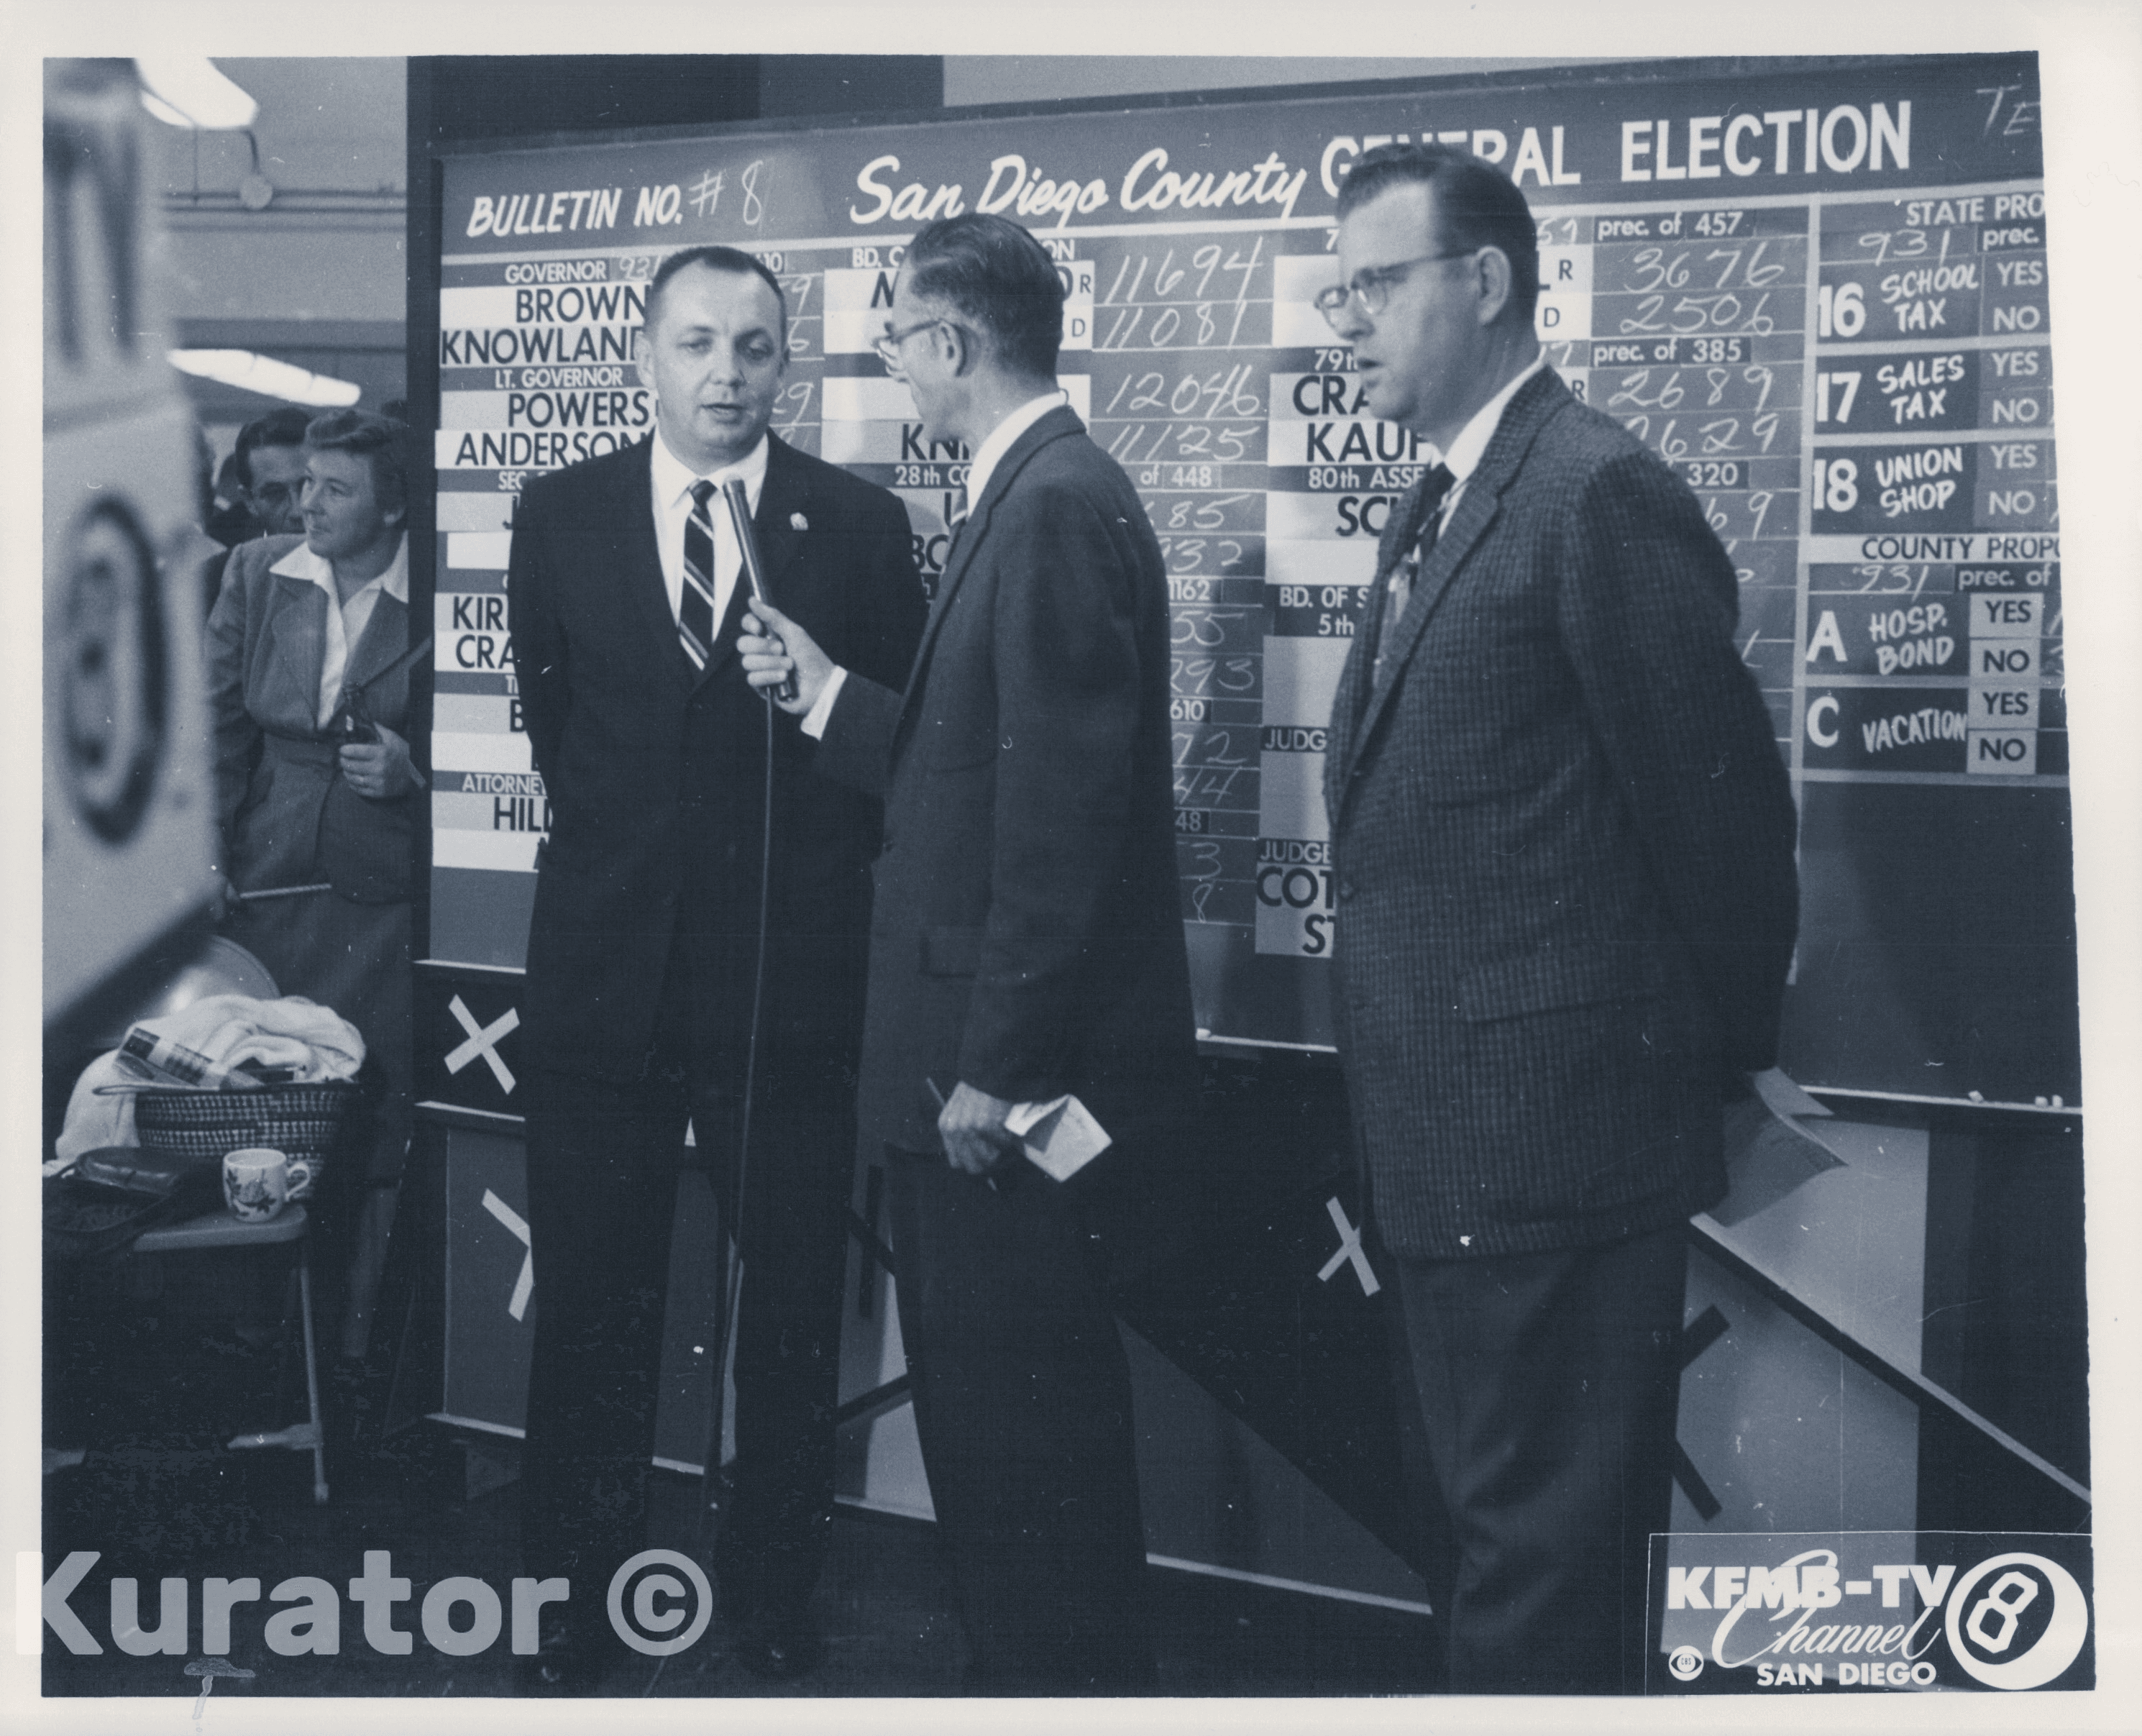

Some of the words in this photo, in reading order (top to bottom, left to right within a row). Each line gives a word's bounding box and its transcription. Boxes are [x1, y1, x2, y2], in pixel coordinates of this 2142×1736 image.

[851, 155, 965, 224] San
[976, 154, 1109, 229] Diego
[1120, 147, 1307, 223] County
[1320, 124, 1581, 198] GRAL
[1621, 100, 1911, 183] ELECTION
[741, 160, 764, 226] 8
[466, 187, 623, 237] BULLETIN
[633, 184, 683, 227] NO.
[1905, 197, 1985, 227] STATE
[1598, 219, 1649, 242] prec.
[1659, 211, 1683, 236] of
[1695, 211, 1744, 236] 457
[1982, 226, 2039, 252] prec.
[505, 260, 606, 284] GOVERNOR
[853, 247, 883, 268] BD.
[1558, 259, 1573, 280] R
[1624, 242, 1785, 293] 3676
[1996, 259, 2044, 287] YES
[1105, 236, 1263, 315] 11694
[1880, 262, 1979, 304] SCHOOL
[515, 284, 652, 324] BROWN
[1543, 307, 1560, 328] D
[1619, 291, 1774, 336] 2506
[1818, 282, 1867, 338] 16
[1892, 298, 1947, 333] TAX
[1992, 304, 2041, 332] NO
[1102, 301, 1246, 349] 11081
[1593, 344, 1645, 367] prec.
[1654, 338, 1677, 361] of
[1692, 339, 1741, 362] 385
[1991, 351, 2039, 377] YES
[495, 369, 516, 390] LT.
[521, 367, 623, 388] GOVERNOR
[1875, 353, 1966, 394] SALES
[1107, 365, 1259, 419] 12046
[1608, 369, 1773, 415] 2689
[1816, 370, 1862, 424] 17
[1890, 388, 1947, 425] TAX
[508, 390, 651, 428] POWERS
[1992, 397, 2040, 424] NO
[1875, 446, 1964, 488] UNION
[1990, 444, 2038, 470] YES
[895, 465, 940, 486] 28th
[1140, 466, 1160, 485] of
[1172, 466, 1212, 487] 448
[1308, 467, 1360, 490] 80th
[1687, 462, 1739, 487] 320
[1812, 458, 1859, 513] 18
[1880, 478, 1956, 518] SHOP
[1988, 489, 2036, 516] NO
[1861, 537, 1974, 560] COUNTY
[1959, 570, 2015, 591] prec.
[2026, 562, 2053, 587] of
[1279, 586, 1314, 608] BD.
[1321, 585, 1349, 608] OF
[1985, 600, 2033, 623] YES
[1805, 610, 1849, 662] A
[1869, 603, 1948, 642] HOSP.
[1875, 636, 1956, 676] BOND
[1982, 649, 2031, 673] NO
[1982, 692, 2029, 716] YES
[1806, 695, 1841, 748] C
[1862, 708, 1969, 754] VACATION
[1979, 737, 2027, 762] NO
